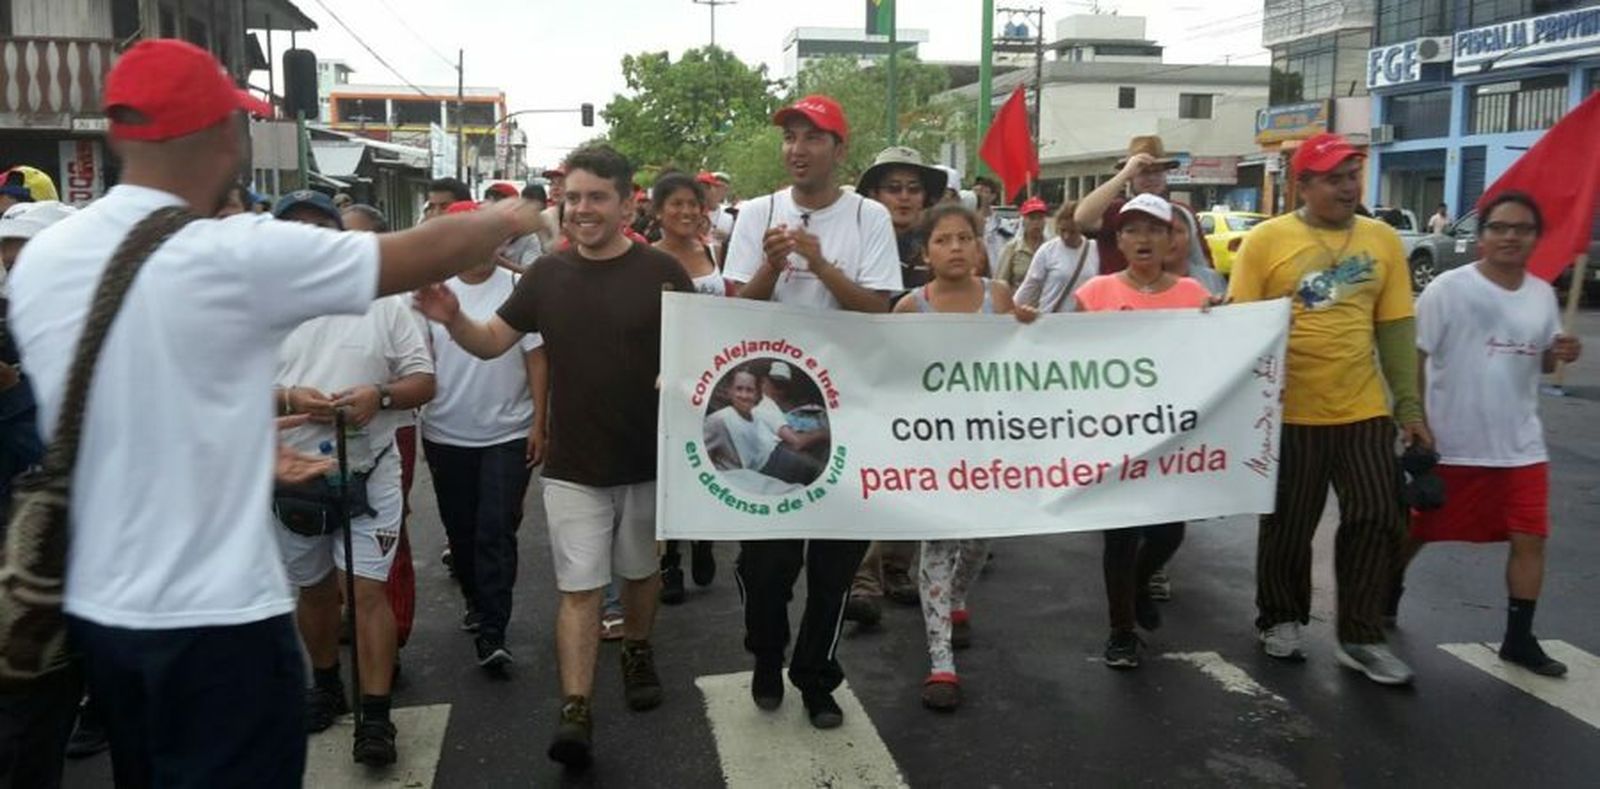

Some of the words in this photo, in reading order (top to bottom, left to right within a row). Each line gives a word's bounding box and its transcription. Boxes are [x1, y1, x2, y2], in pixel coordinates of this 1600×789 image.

[1457, 22, 1527, 57] FISCALIA
[1370, 43, 1418, 86] FGE
[692, 370, 713, 406] con
[713, 339, 803, 370] Alejandro
[805, 357, 818, 370] e
[817, 369, 840, 409] Inés
[922, 358, 1158, 392] CAMINAMOS
[892, 417, 955, 441] con
[966, 404, 1199, 441] misericordia
[685, 440, 702, 469] en
[698, 471, 771, 516] defensa
[776, 497, 804, 514] de
[806, 485, 827, 504] la
[826, 444, 848, 486] vida
[860, 466, 939, 499] para
[948, 454, 1111, 490] defender
[1119, 454, 1149, 481] la
[1158, 444, 1227, 476] vida
